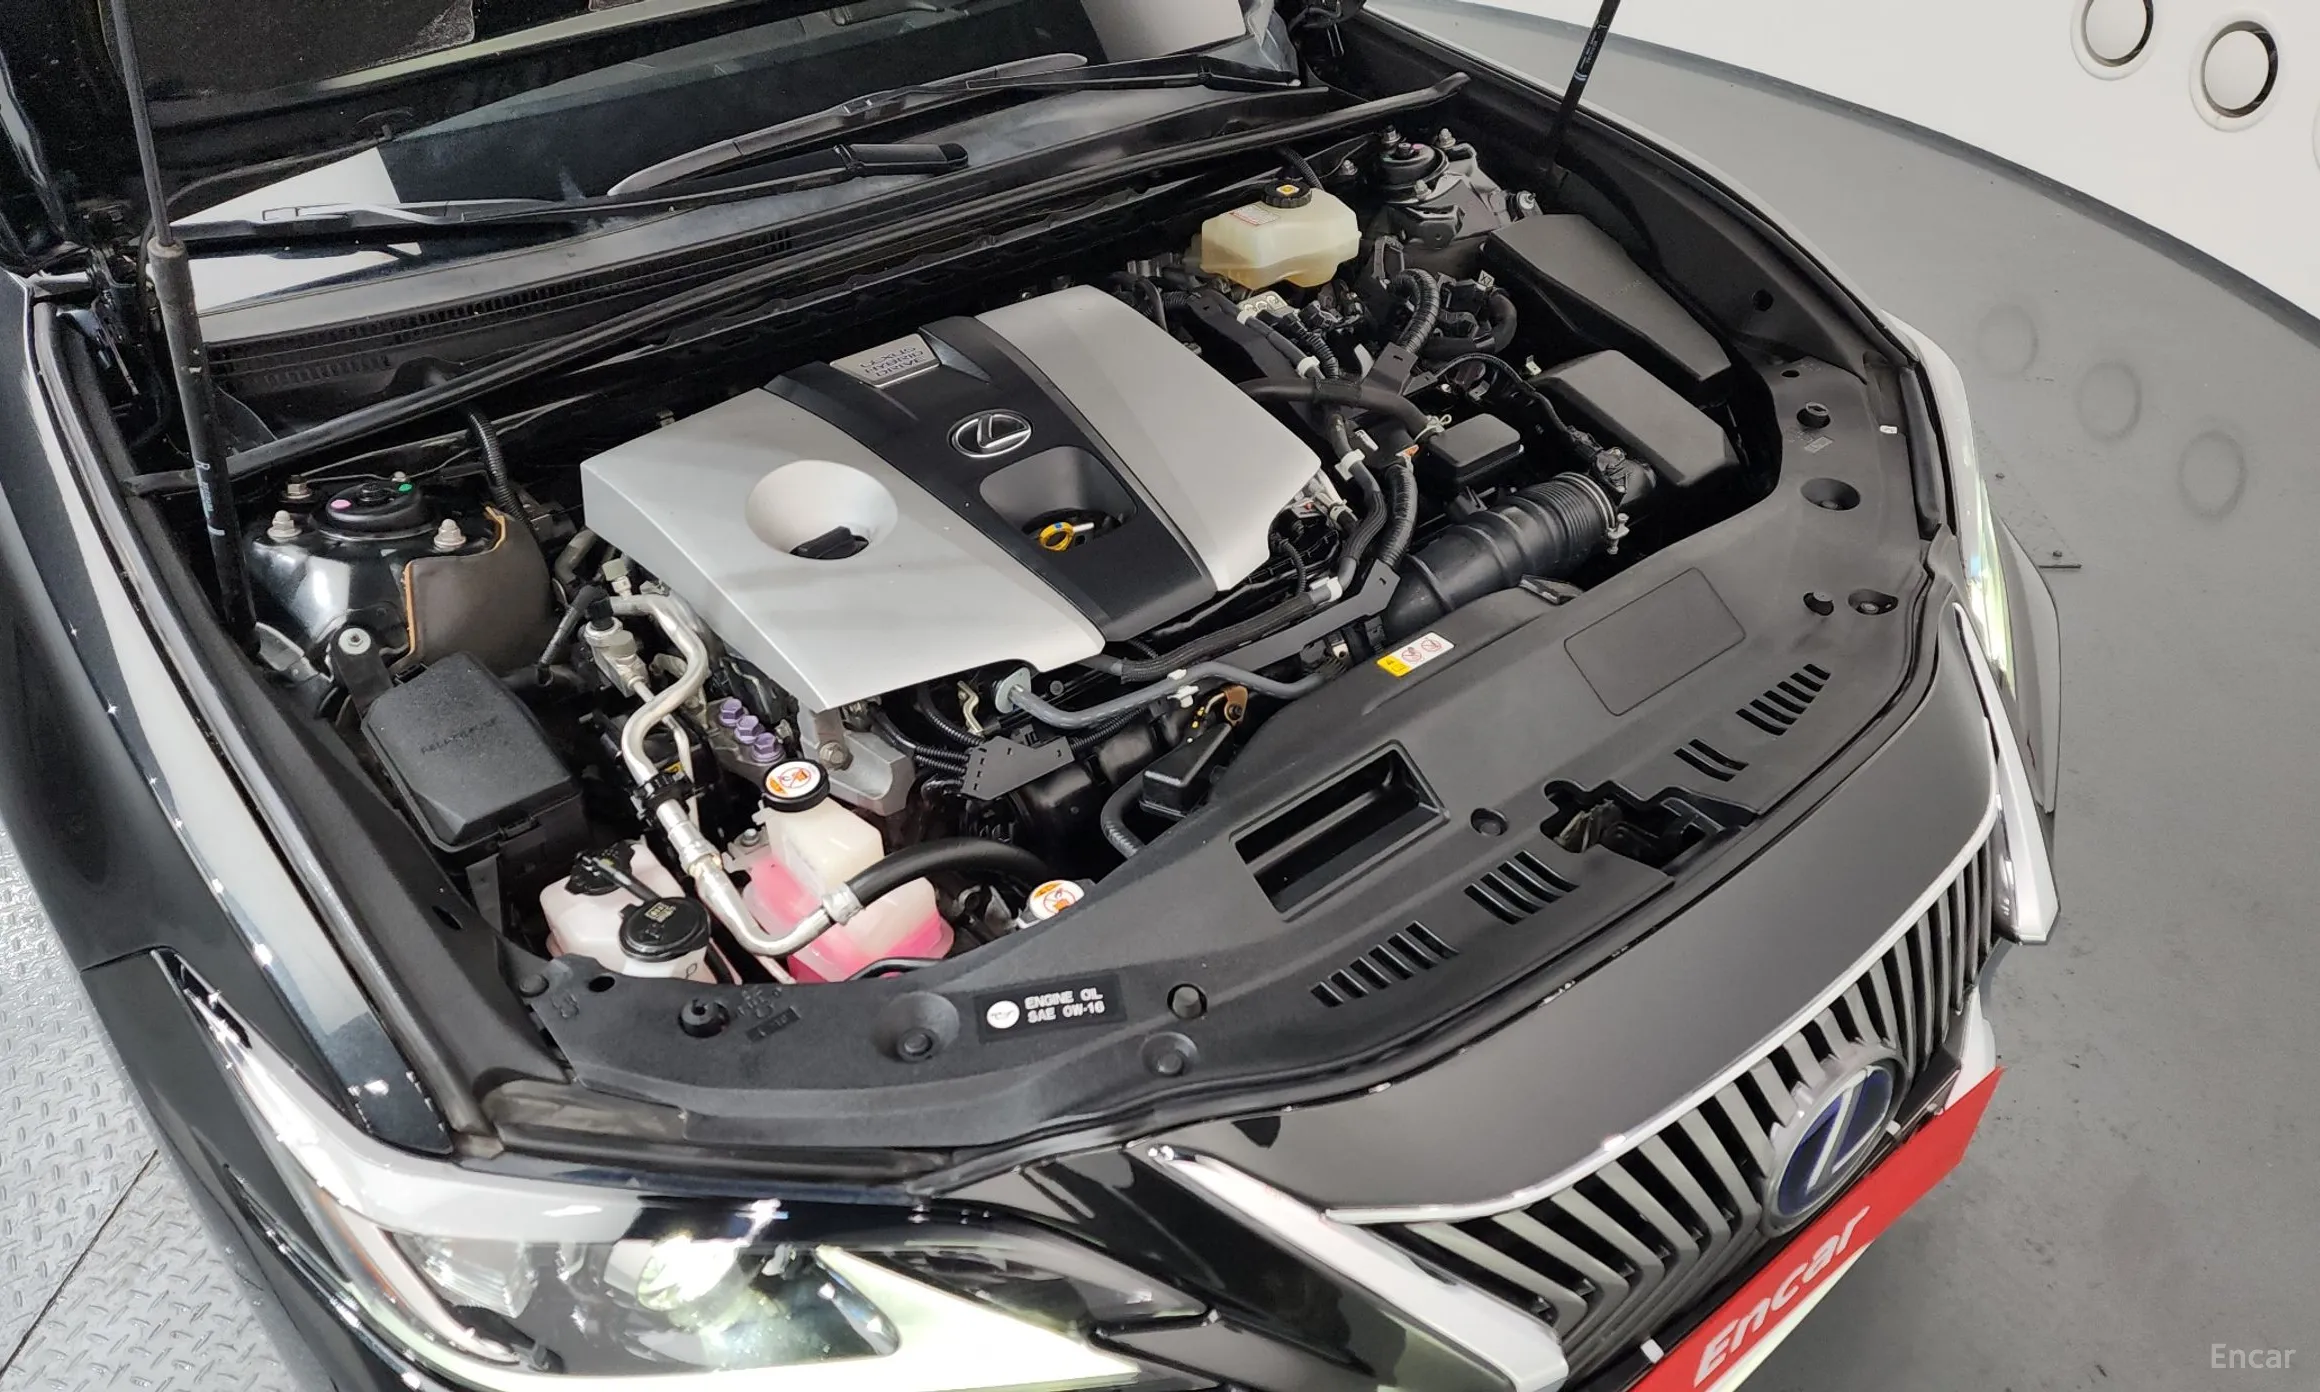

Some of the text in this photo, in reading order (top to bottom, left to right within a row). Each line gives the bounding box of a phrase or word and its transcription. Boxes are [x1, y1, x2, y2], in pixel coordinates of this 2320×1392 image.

[860, 346, 916, 367] LEXUS
[865, 350, 924, 374] HYBRID
[875, 357, 925, 377] DRIVE
[1024, 987, 1103, 1010] ENGINE OIL
[1027, 1001, 1105, 1024] SAE 0W-16
[1693, 1205, 1871, 1387] Encar
